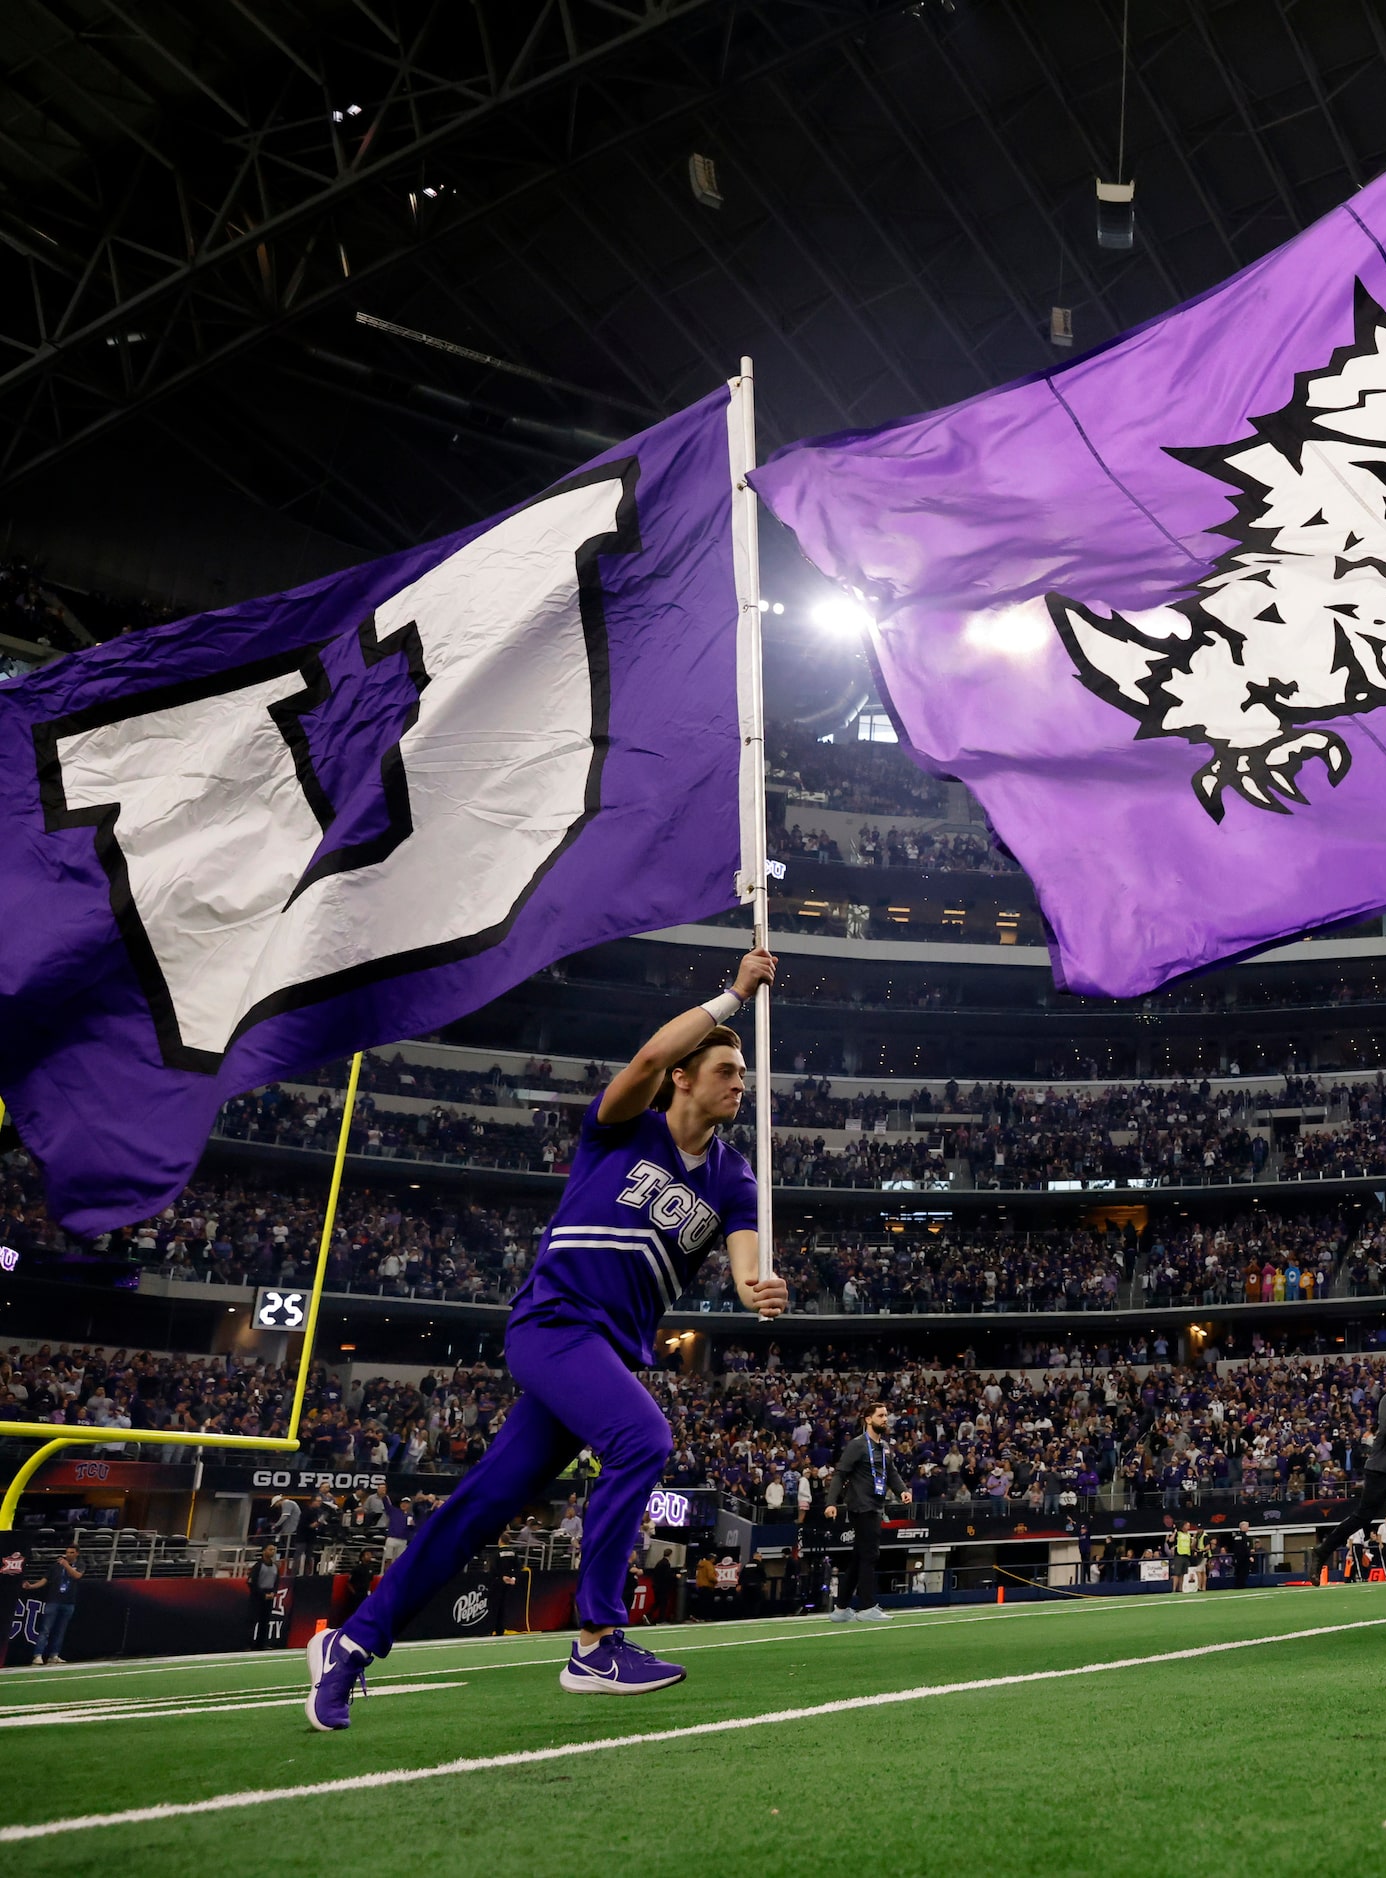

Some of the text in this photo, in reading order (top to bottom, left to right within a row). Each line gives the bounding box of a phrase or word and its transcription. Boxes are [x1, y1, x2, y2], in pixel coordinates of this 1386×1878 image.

[616, 1159, 721, 1255] TCU
[259, 1292, 303, 1326] 25
[75, 1463, 110, 1480] TCU
[253, 1470, 387, 1489] GO FROGS
[897, 1528, 929, 1538] ESPN
[453, 1590, 488, 1623] Dr Pepper
